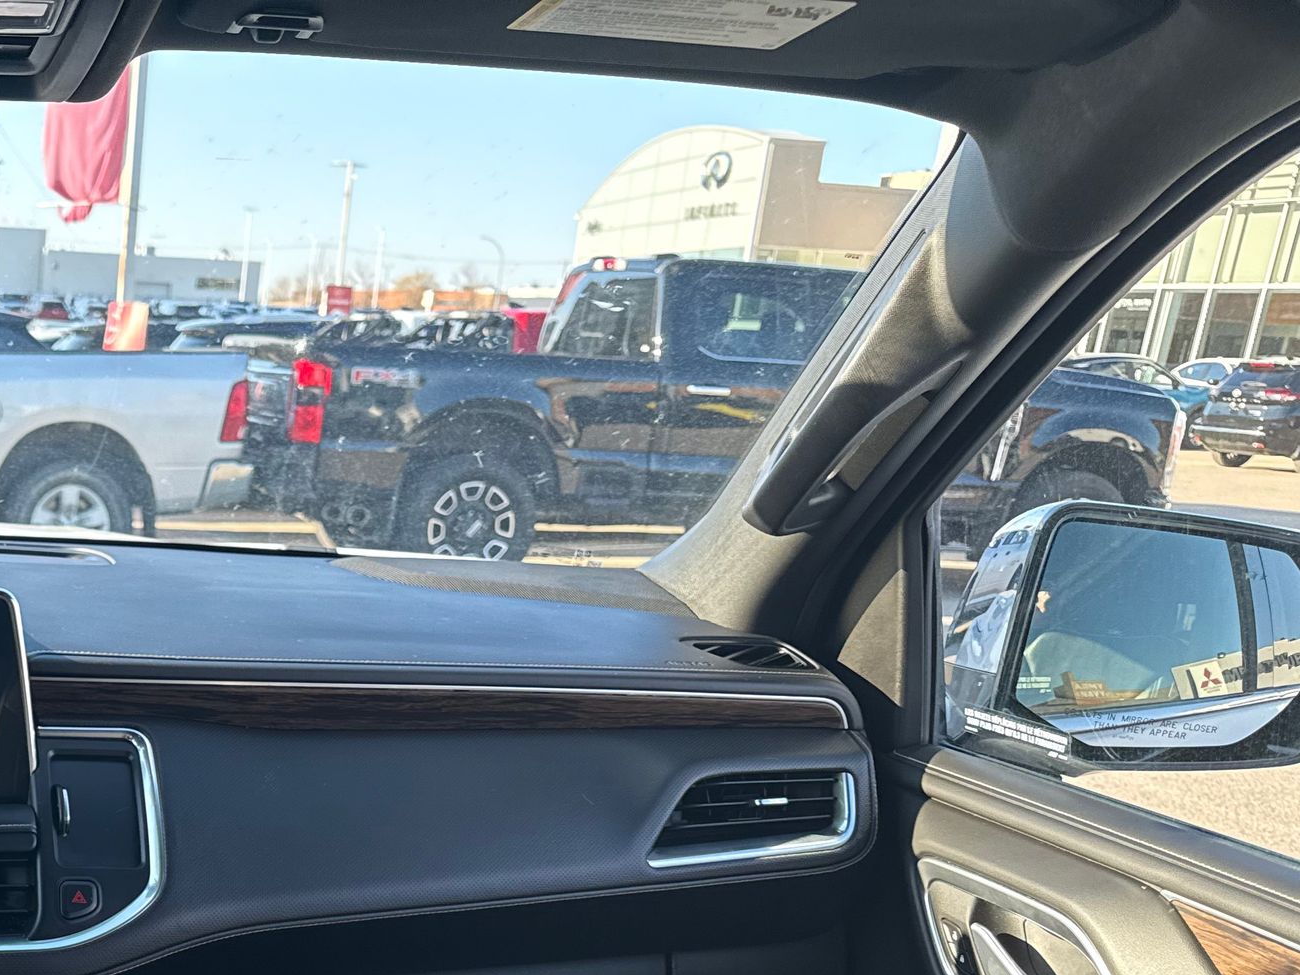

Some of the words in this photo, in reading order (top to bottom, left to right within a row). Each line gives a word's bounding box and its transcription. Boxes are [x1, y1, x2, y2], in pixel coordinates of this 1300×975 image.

[1160, 719, 1177, 730] ARE
[1182, 722, 1218, 734] CLOSER
[1148, 729, 1187, 740] APPEAR
